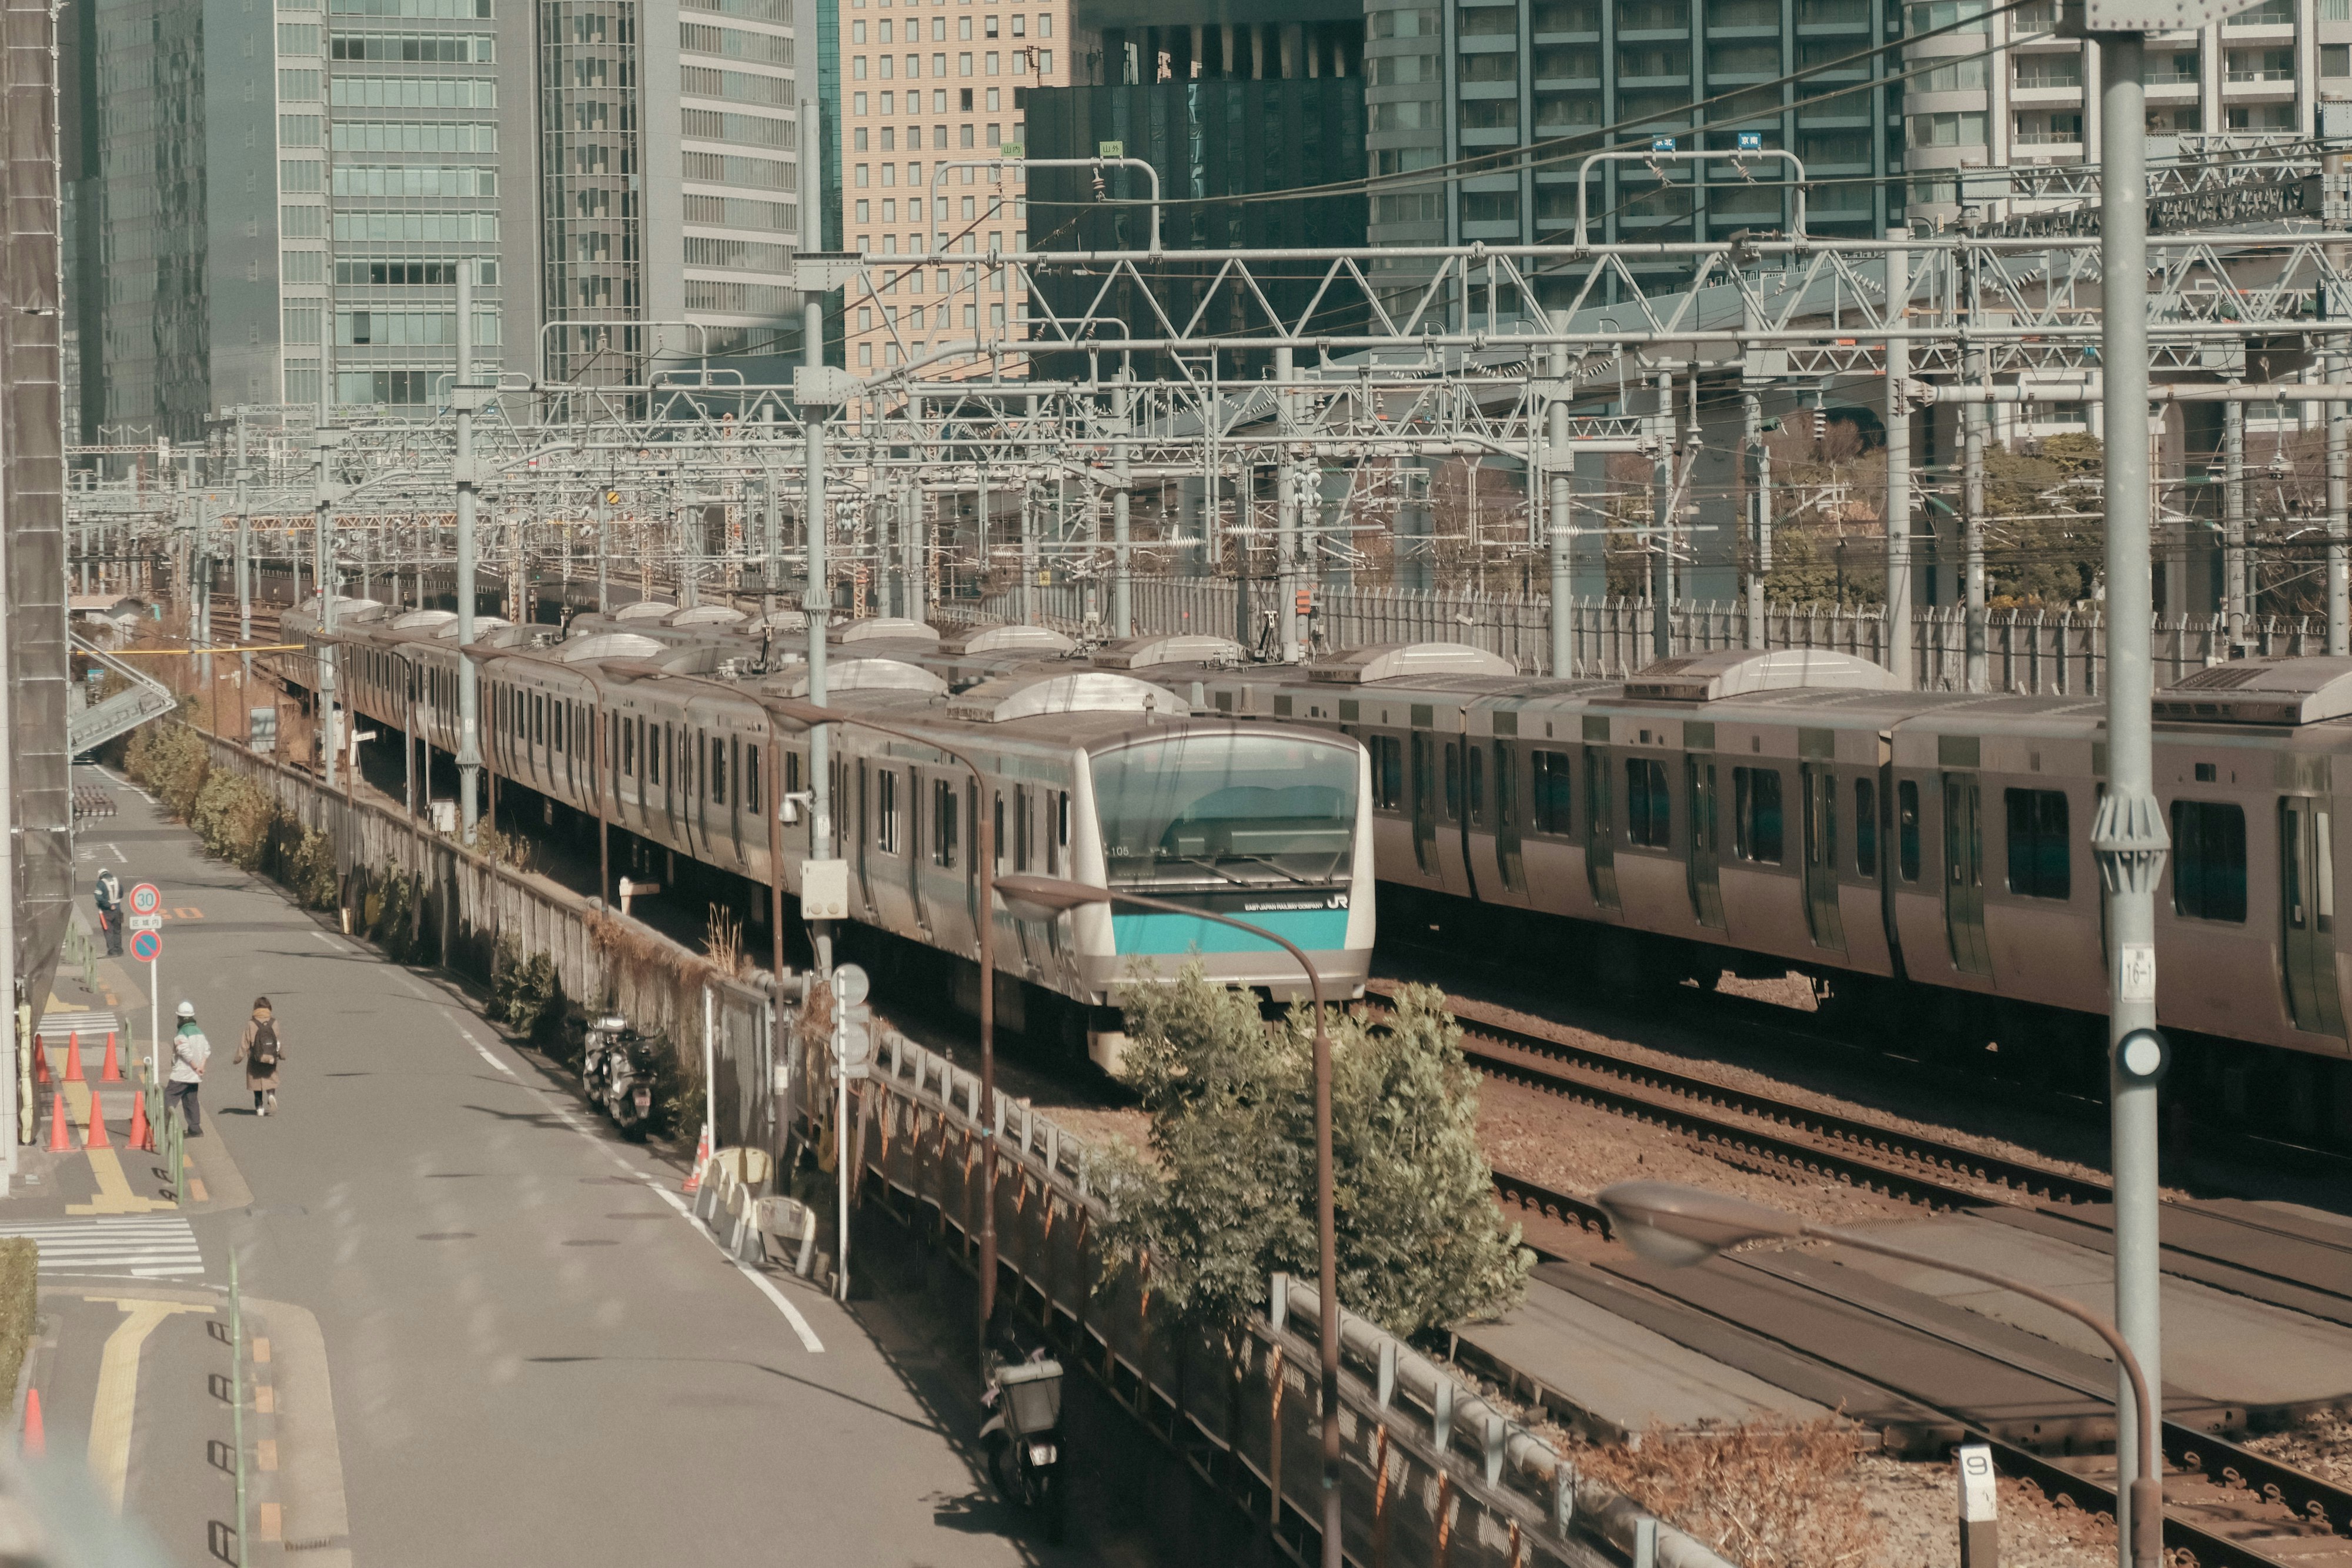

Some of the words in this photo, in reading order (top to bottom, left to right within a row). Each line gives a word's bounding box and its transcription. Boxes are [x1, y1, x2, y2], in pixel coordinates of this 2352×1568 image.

[1741, 136, 1758, 145] 京南
[1003, 145, 1021, 154] 山内
[1102, 144, 1120, 153] 山外
[1112, 847, 1129, 856] 105
[137, 892, 153, 907] 30
[1327, 894, 1348, 909] JR
[1966, 1456, 1988, 1476] 9
